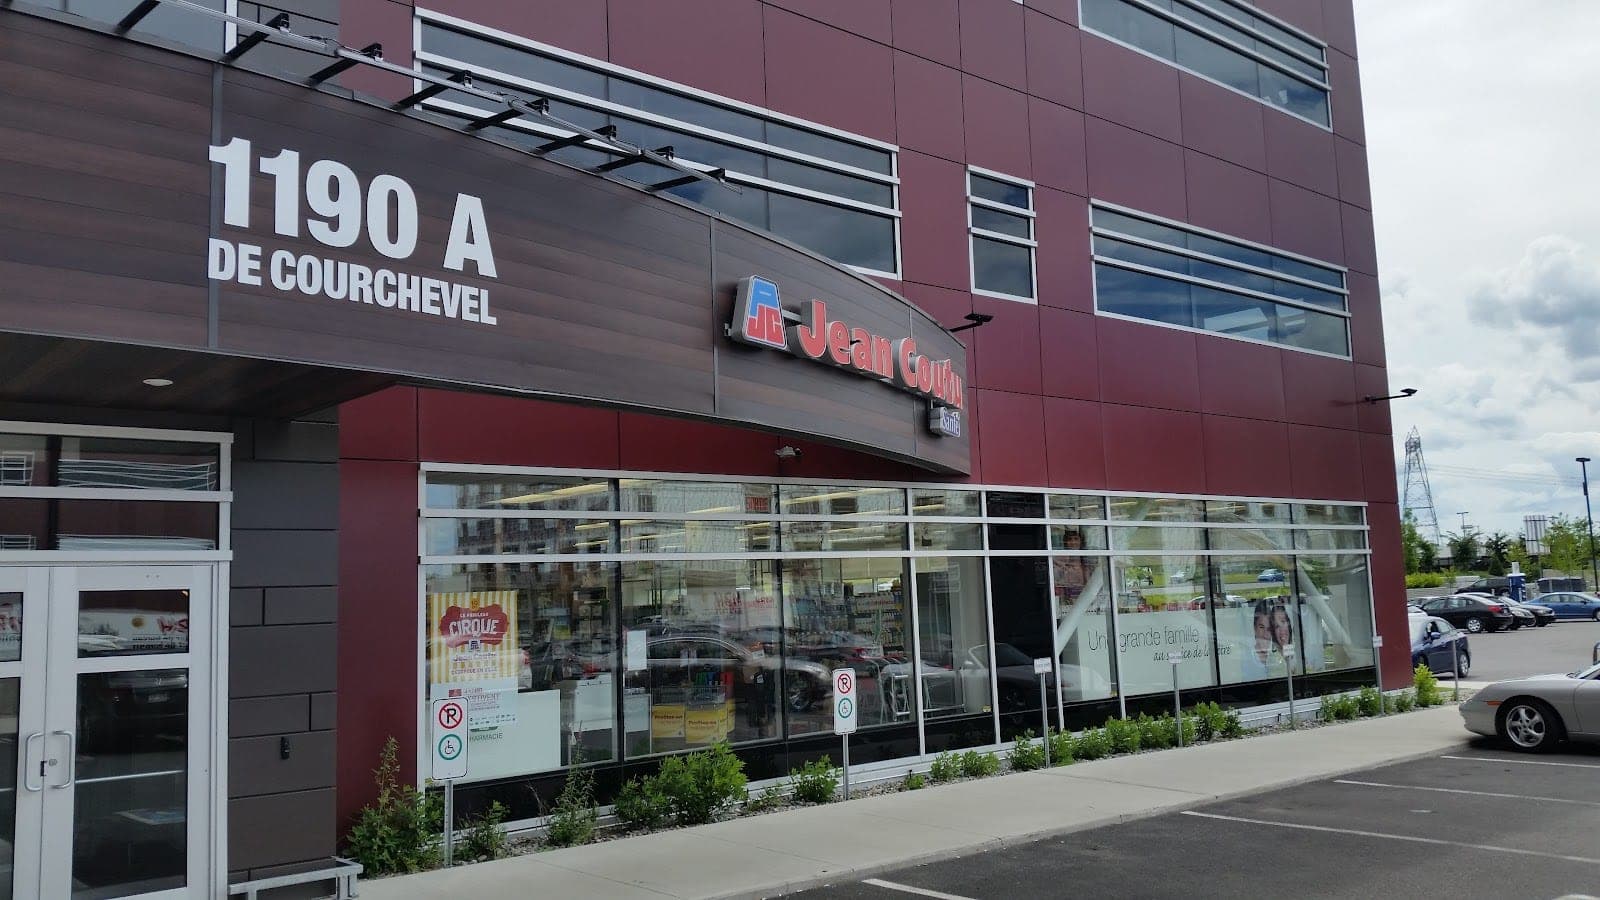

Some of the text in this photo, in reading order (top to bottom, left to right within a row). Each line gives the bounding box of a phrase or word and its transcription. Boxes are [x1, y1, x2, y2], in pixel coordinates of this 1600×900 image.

[208, 137, 497, 278] 1190 A
[208, 238, 497, 325] DE COURCHEVEL
[797, 299, 963, 409] Jean Coutu
[449, 618, 499, 638] CIRQUE
[1119, 627, 1160, 652] grande
[1164, 625, 1198, 644] famille
